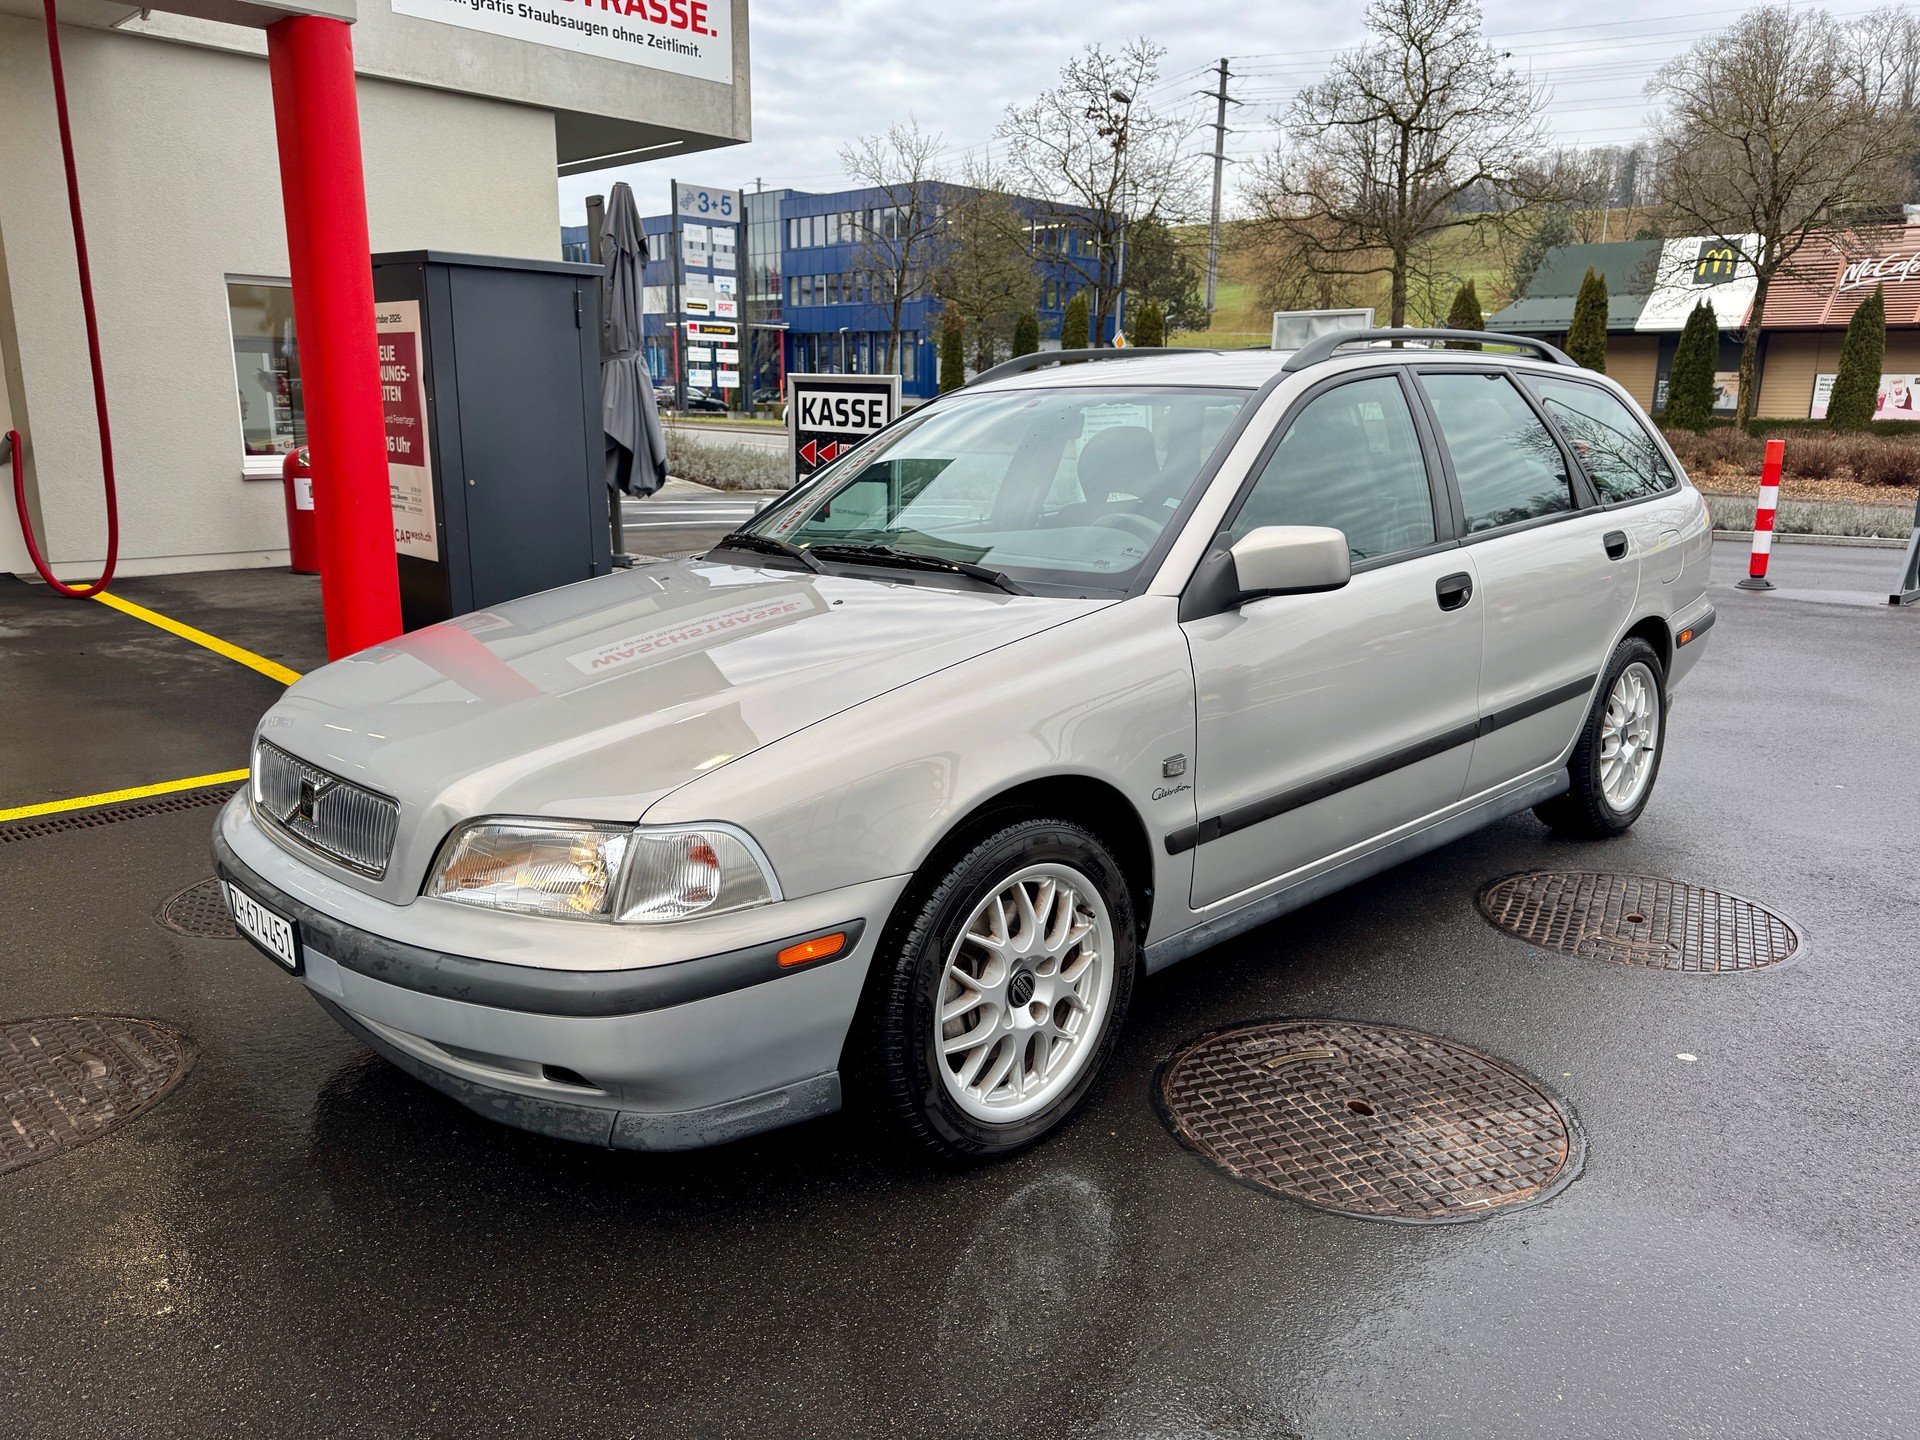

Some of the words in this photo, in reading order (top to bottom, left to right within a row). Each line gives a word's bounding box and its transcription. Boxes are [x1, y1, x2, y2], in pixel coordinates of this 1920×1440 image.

[471, 0, 514, 15] gratis
[518, 3, 609, 36] Staubsaugen
[612, 26, 644, 44] ohne
[647, 33, 702, 58] Zeitlimit.
[562, 0, 718, 38] ASSE.
[378, 345, 396, 361] EUE
[802, 397, 883, 429] KASSE
[396, 436, 411, 453] Uhr
[1016, 978, 1032, 1000] VOLVO
